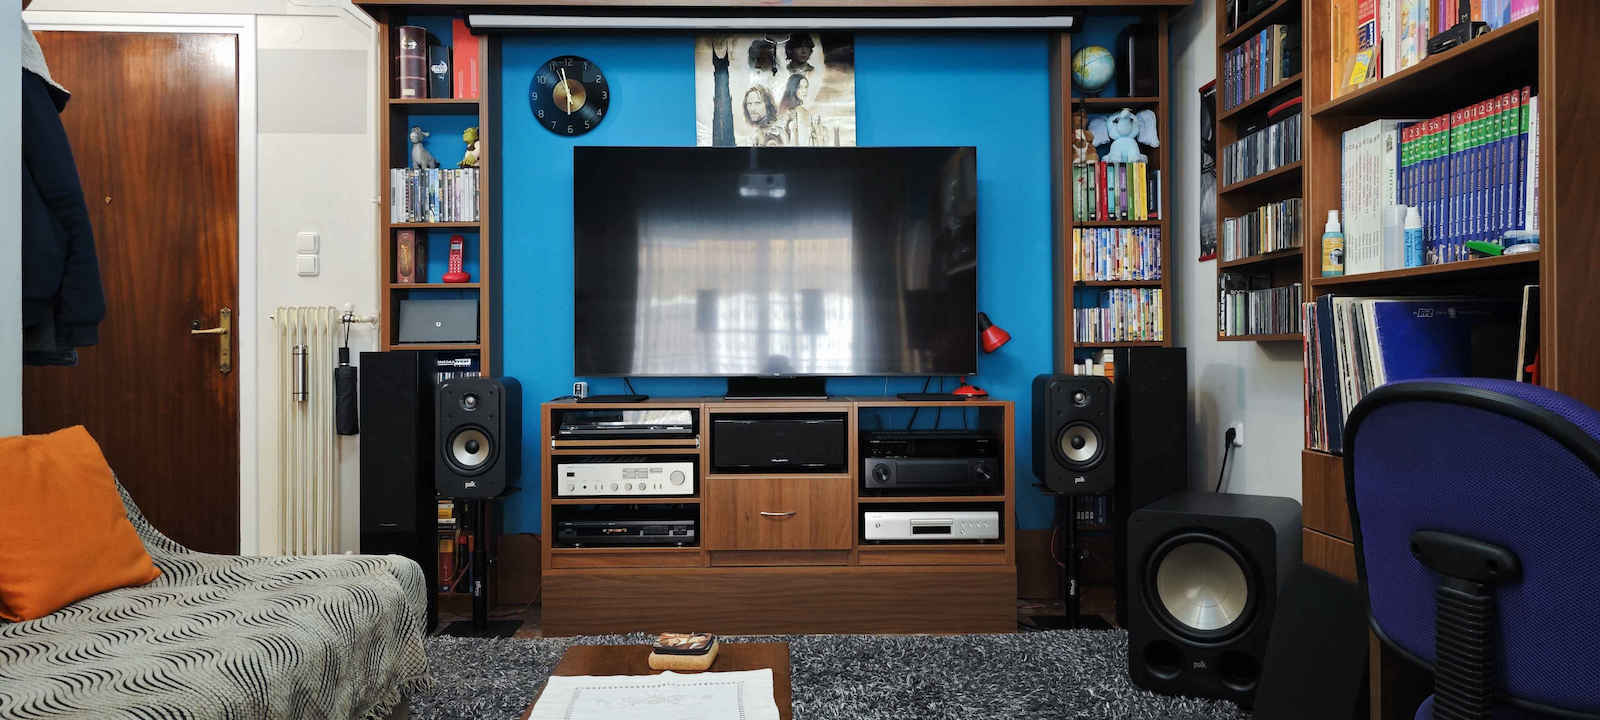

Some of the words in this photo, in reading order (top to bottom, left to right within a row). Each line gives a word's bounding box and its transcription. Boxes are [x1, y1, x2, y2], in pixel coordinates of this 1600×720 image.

[564, 58, 574, 66] 12
[537, 75, 546, 84] 10
[595, 74, 602, 84] 2
[532, 92, 538, 100] 9
[601, 91, 608, 100] 3
[537, 109, 545, 118] 8
[552, 120, 557, 129] 7
[584, 120, 590, 128] 5
[567, 125, 574, 134] 6
